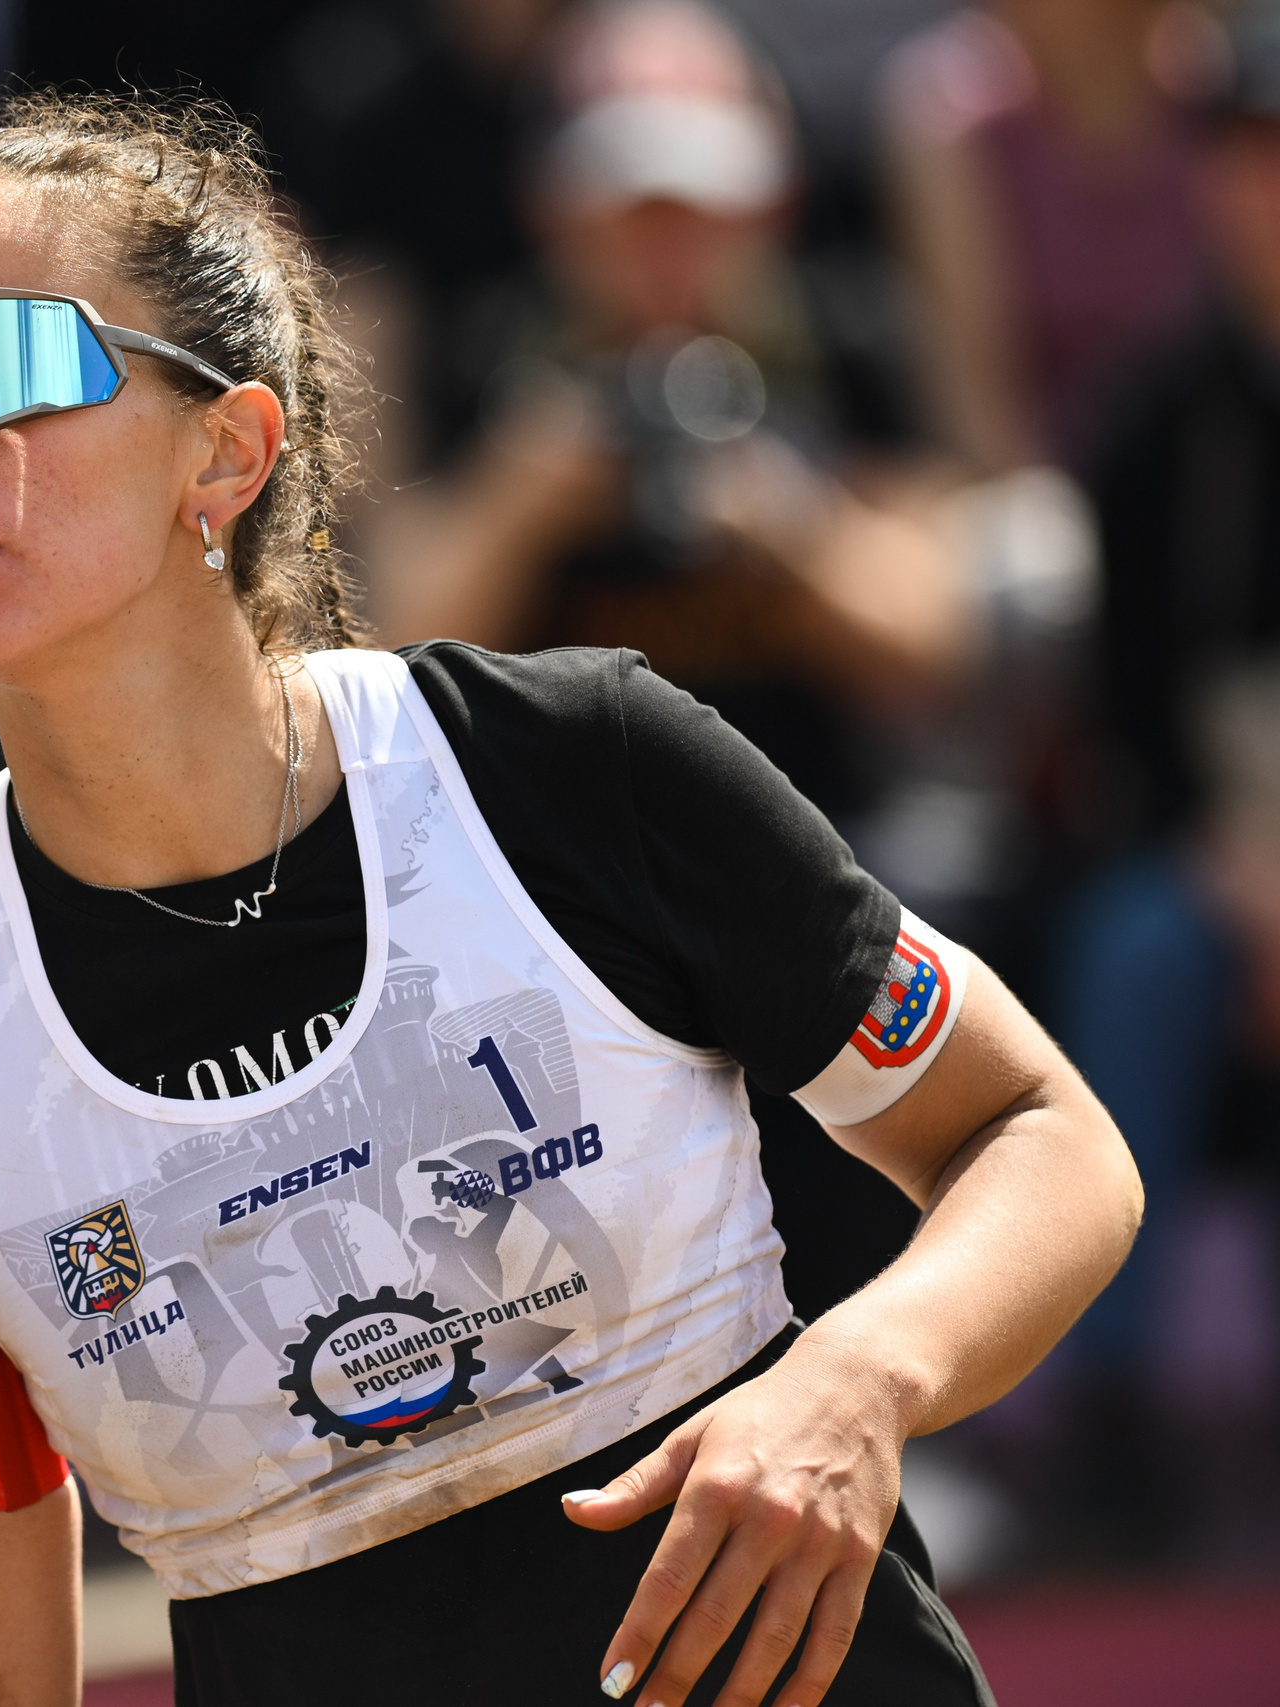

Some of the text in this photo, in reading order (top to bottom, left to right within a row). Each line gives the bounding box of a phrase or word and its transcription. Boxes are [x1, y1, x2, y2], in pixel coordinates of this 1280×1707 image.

[31, 303, 63, 311] EXENZA
[151, 342, 178, 356] EXENZA
[467, 1035, 538, 1133] 1
[218, 1140, 371, 1227] ENSEN
[497, 1122, 604, 1198] ВФВ
[67, 1299, 186, 1369] ТУЛИЦА
[329, 1317, 398, 1357] СОЮЗ
[340, 1271, 588, 1379] МАШИНОСТРОИТЕЛЕЙ
[353, 1352, 443, 1399] РОССИИ
